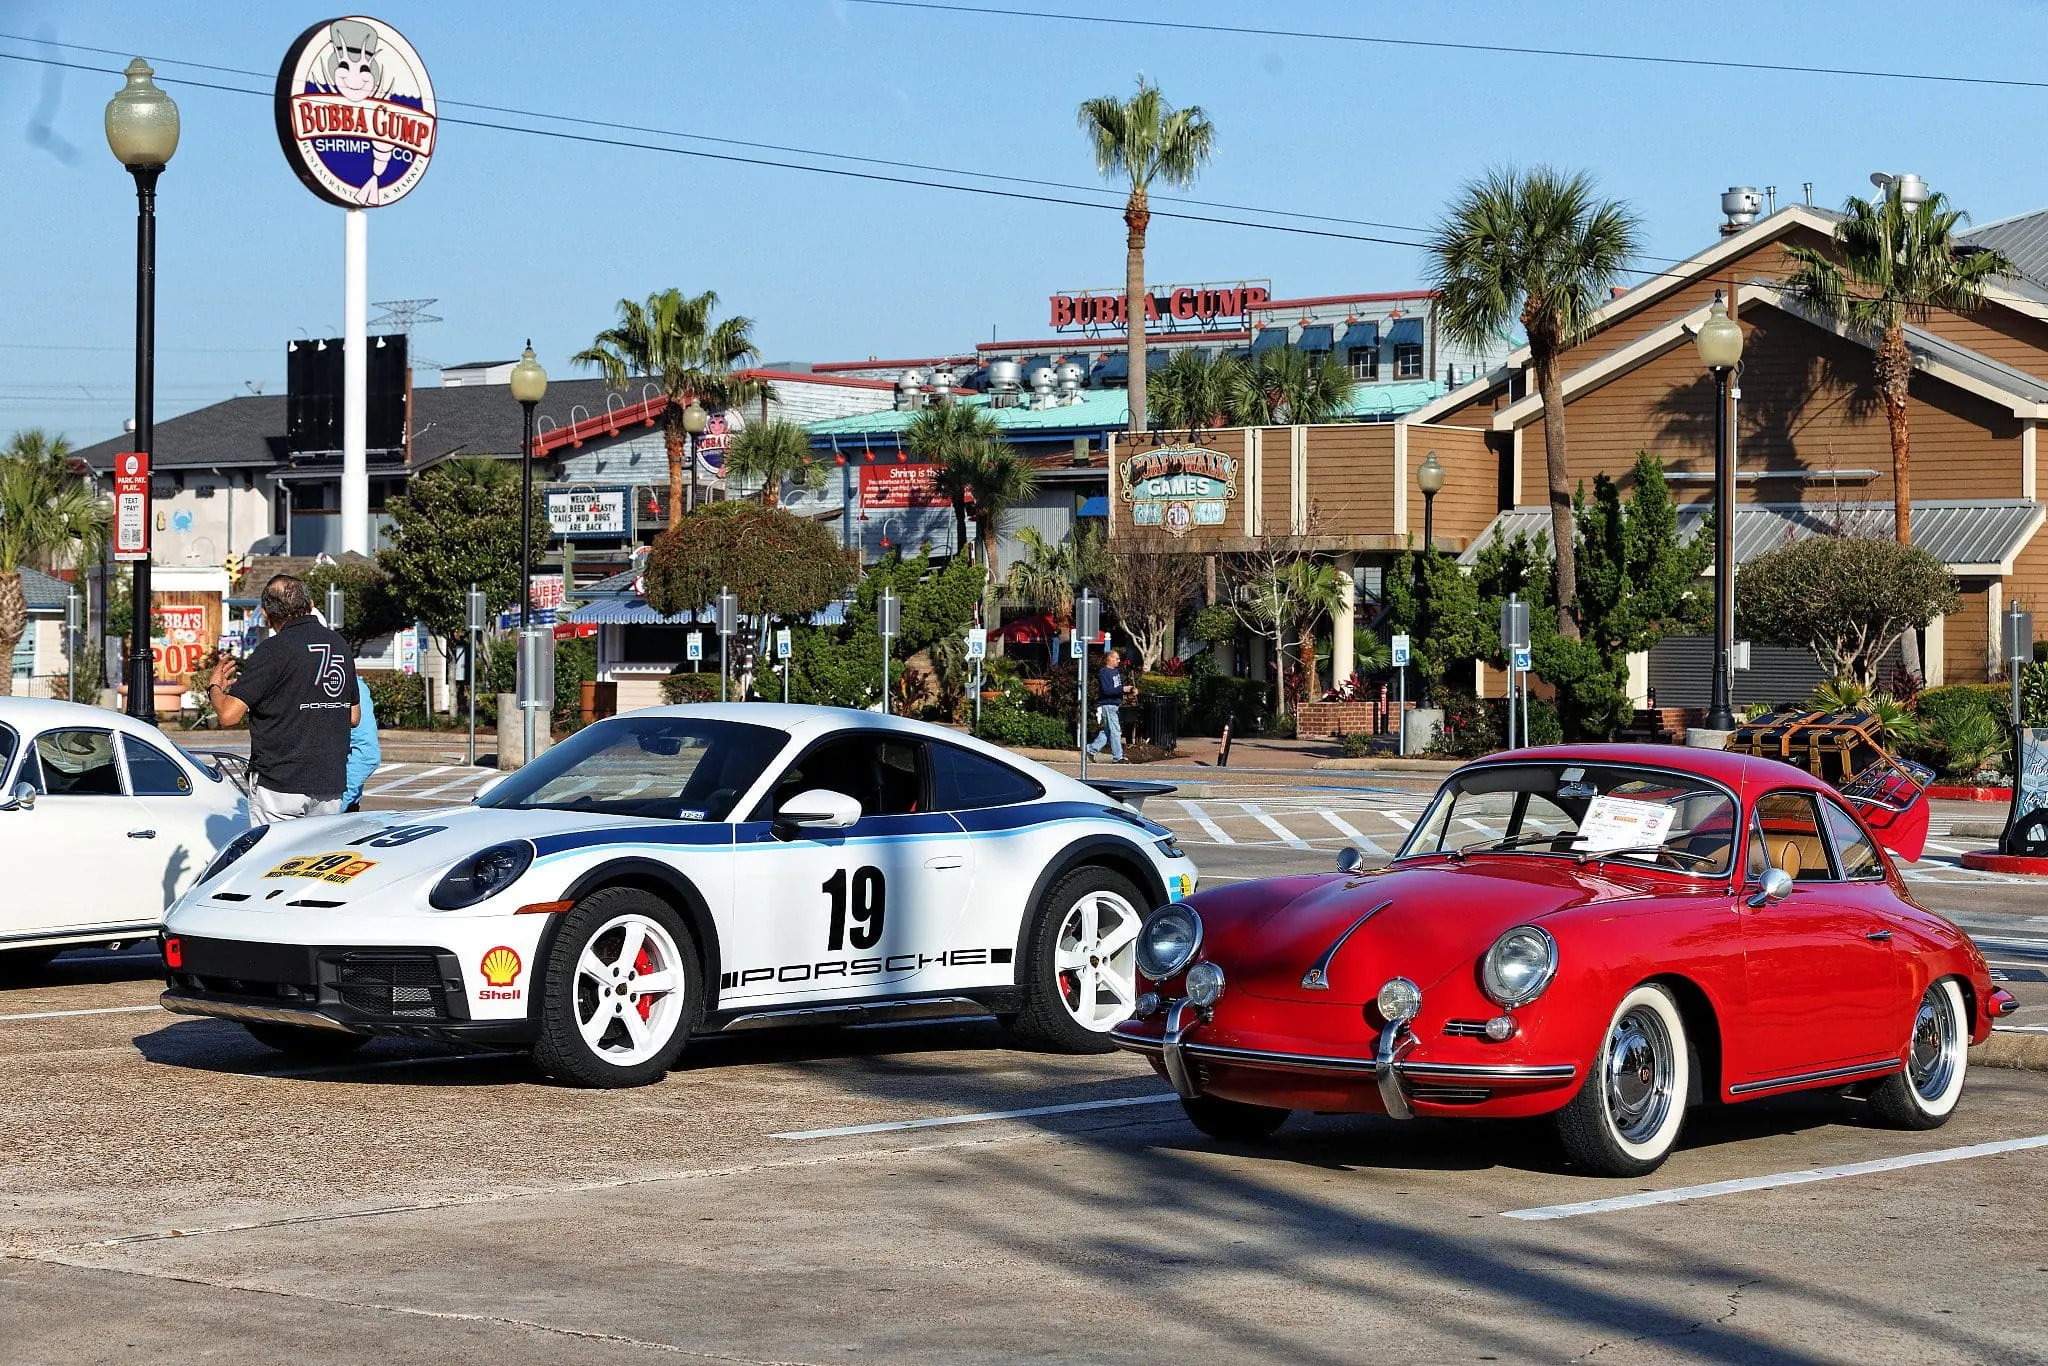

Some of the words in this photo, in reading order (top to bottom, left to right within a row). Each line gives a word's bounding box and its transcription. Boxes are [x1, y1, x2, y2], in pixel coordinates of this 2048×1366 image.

[299, 101, 368, 134] BUBBA
[373, 104, 429, 147] GUMP
[315, 139, 370, 153] SHRIMP
[890, 468, 916, 481] Shrimp
[919, 468, 924, 477] is
[1131, 451, 1228, 484] BOARDWALK
[1148, 478, 1210, 497] GAMES
[550, 505, 566, 513] COLD
[570, 505, 585, 513] BEER
[570, 523, 582, 531] ARE
[586, 523, 601, 531] BACK
[163, 612, 202, 630] BBA'S
[307, 643, 346, 697] 75
[300, 702, 351, 710] PORSCHE
[345, 824, 449, 848] 19
[305, 854, 352, 871] 19
[822, 865, 885, 951] 19
[741, 949, 986, 987] PORSCHE
[479, 990, 520, 999] Shell
